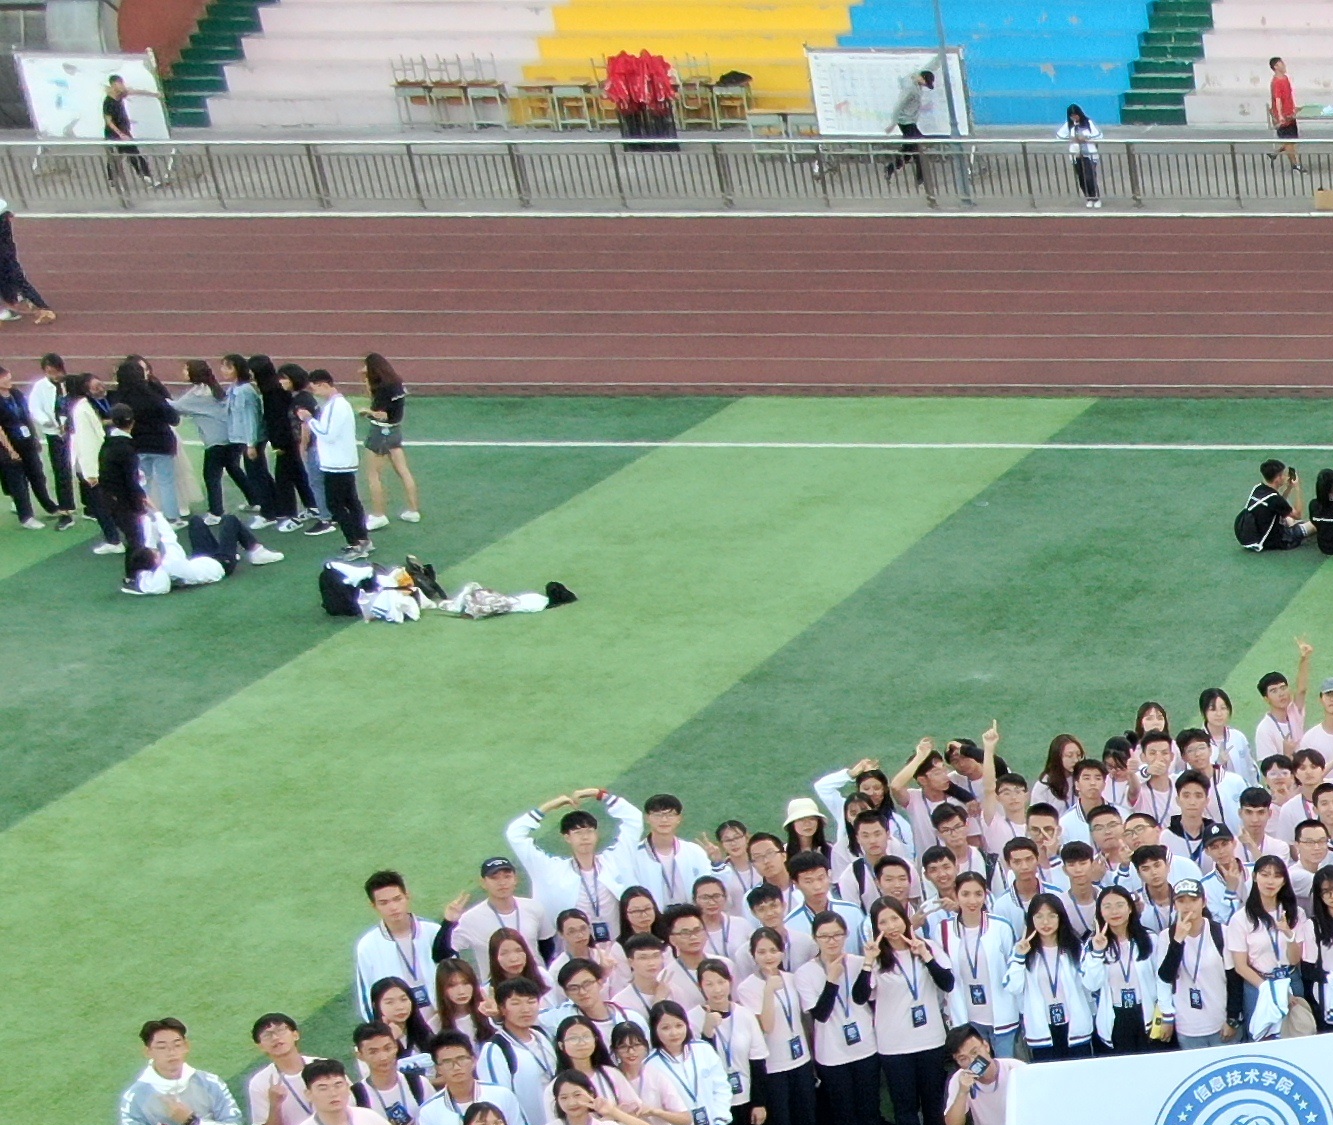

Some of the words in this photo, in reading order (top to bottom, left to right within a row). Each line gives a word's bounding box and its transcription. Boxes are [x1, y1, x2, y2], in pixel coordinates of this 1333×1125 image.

[1194, 1068, 1295, 1103] 信息技术学院
